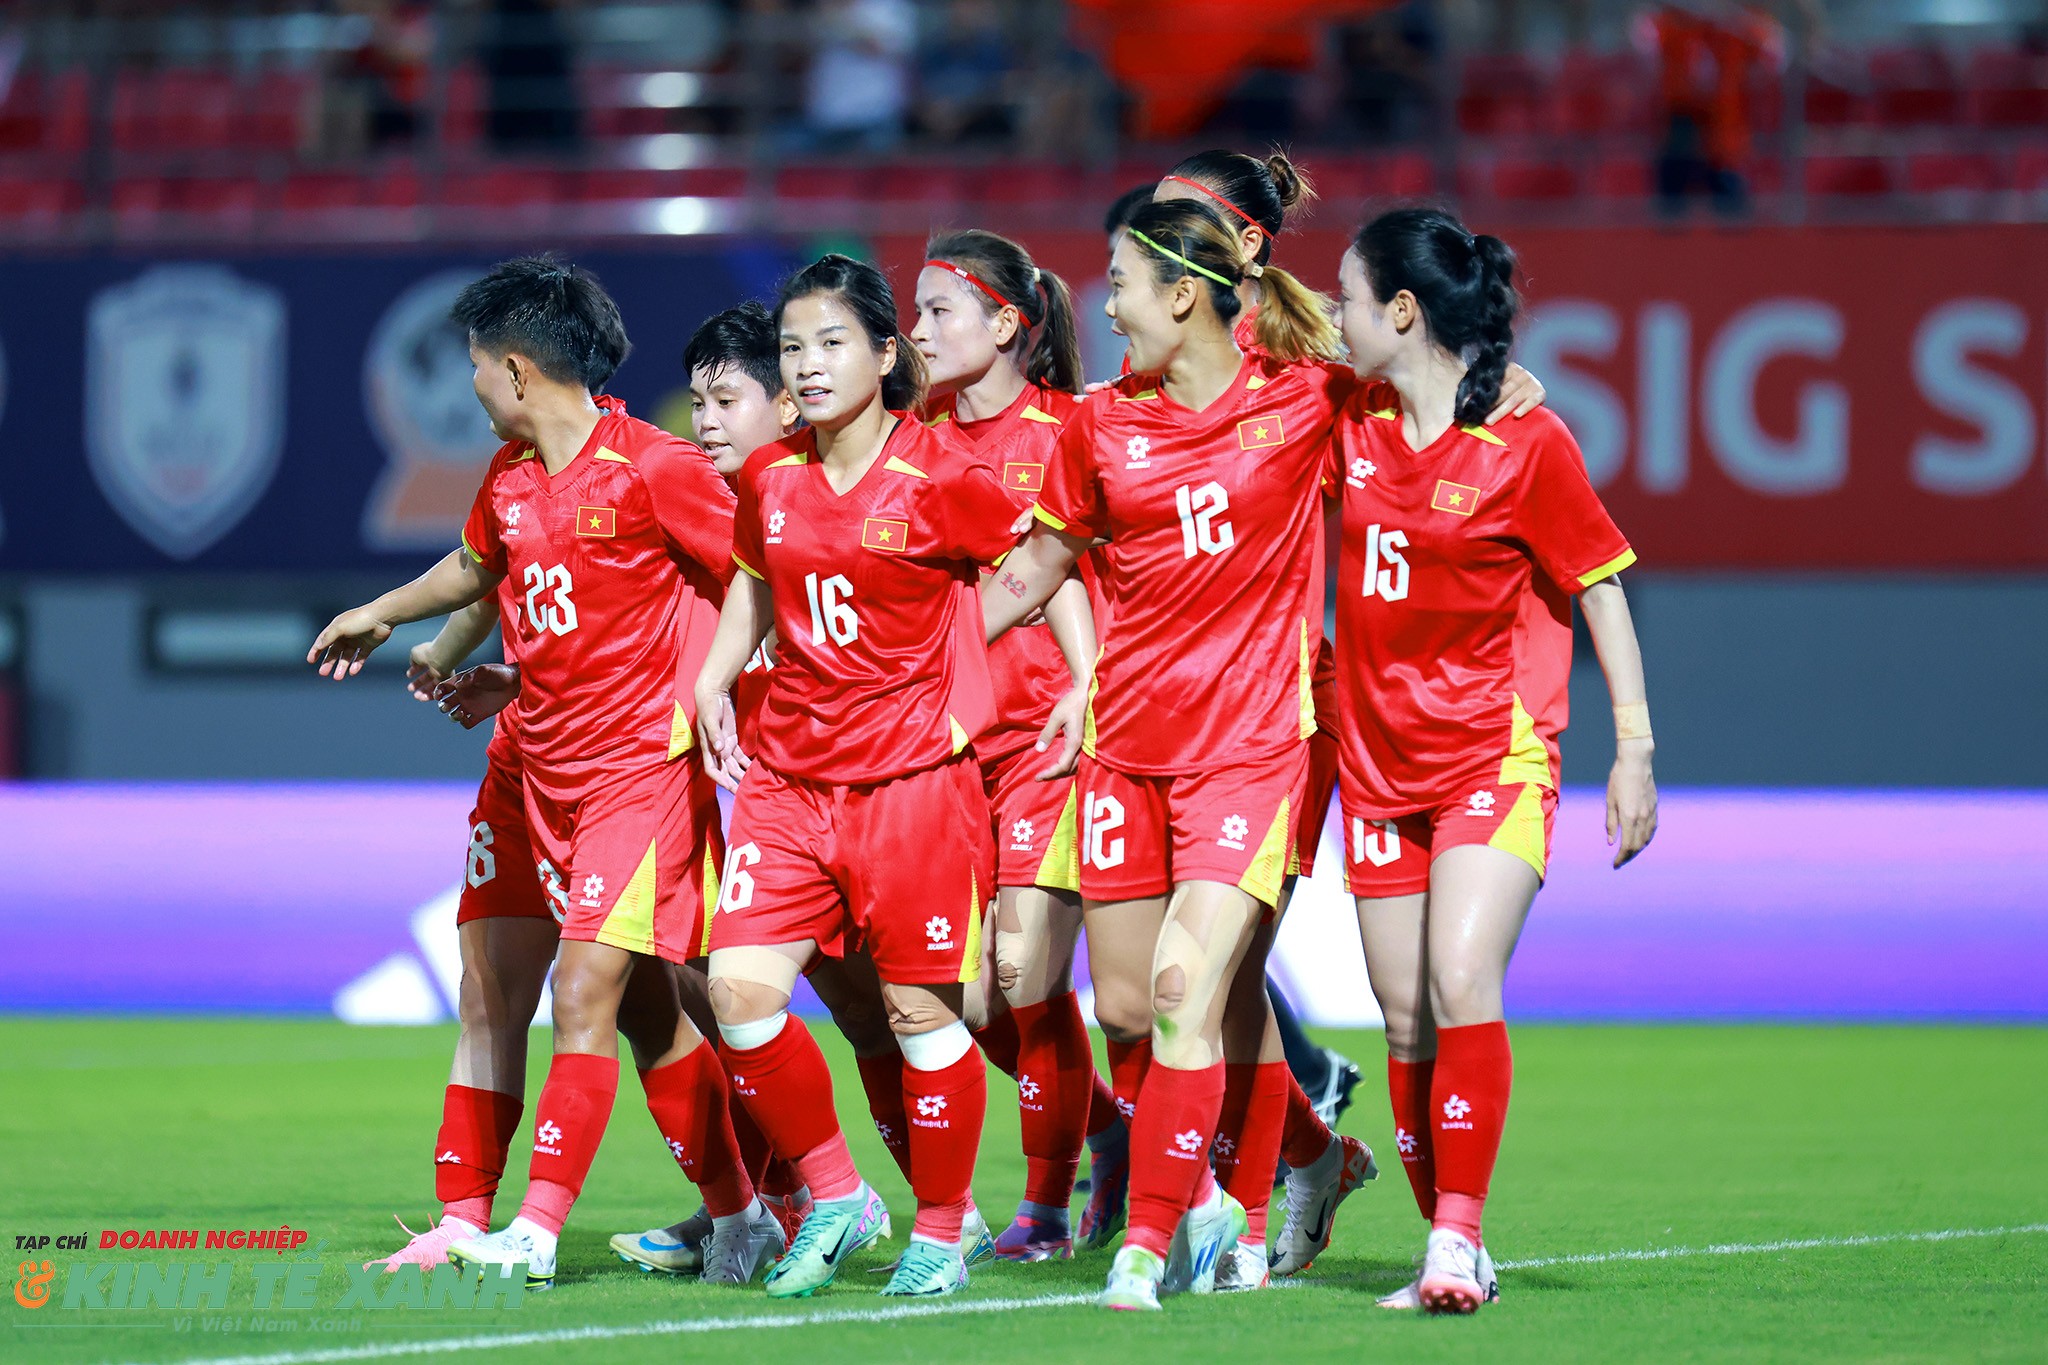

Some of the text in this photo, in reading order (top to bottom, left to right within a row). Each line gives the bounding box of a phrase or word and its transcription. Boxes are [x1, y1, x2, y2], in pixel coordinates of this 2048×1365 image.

[1516, 299, 2048, 494] SIG S
[1175, 481, 1236, 560] 12
[524, 561, 579, 637] 23
[1362, 524, 1411, 602] 15
[805, 572, 859, 648] 16
[461, 821, 497, 893] 8
[1082, 790, 1126, 871] 12
[537, 858, 570, 924] 3
